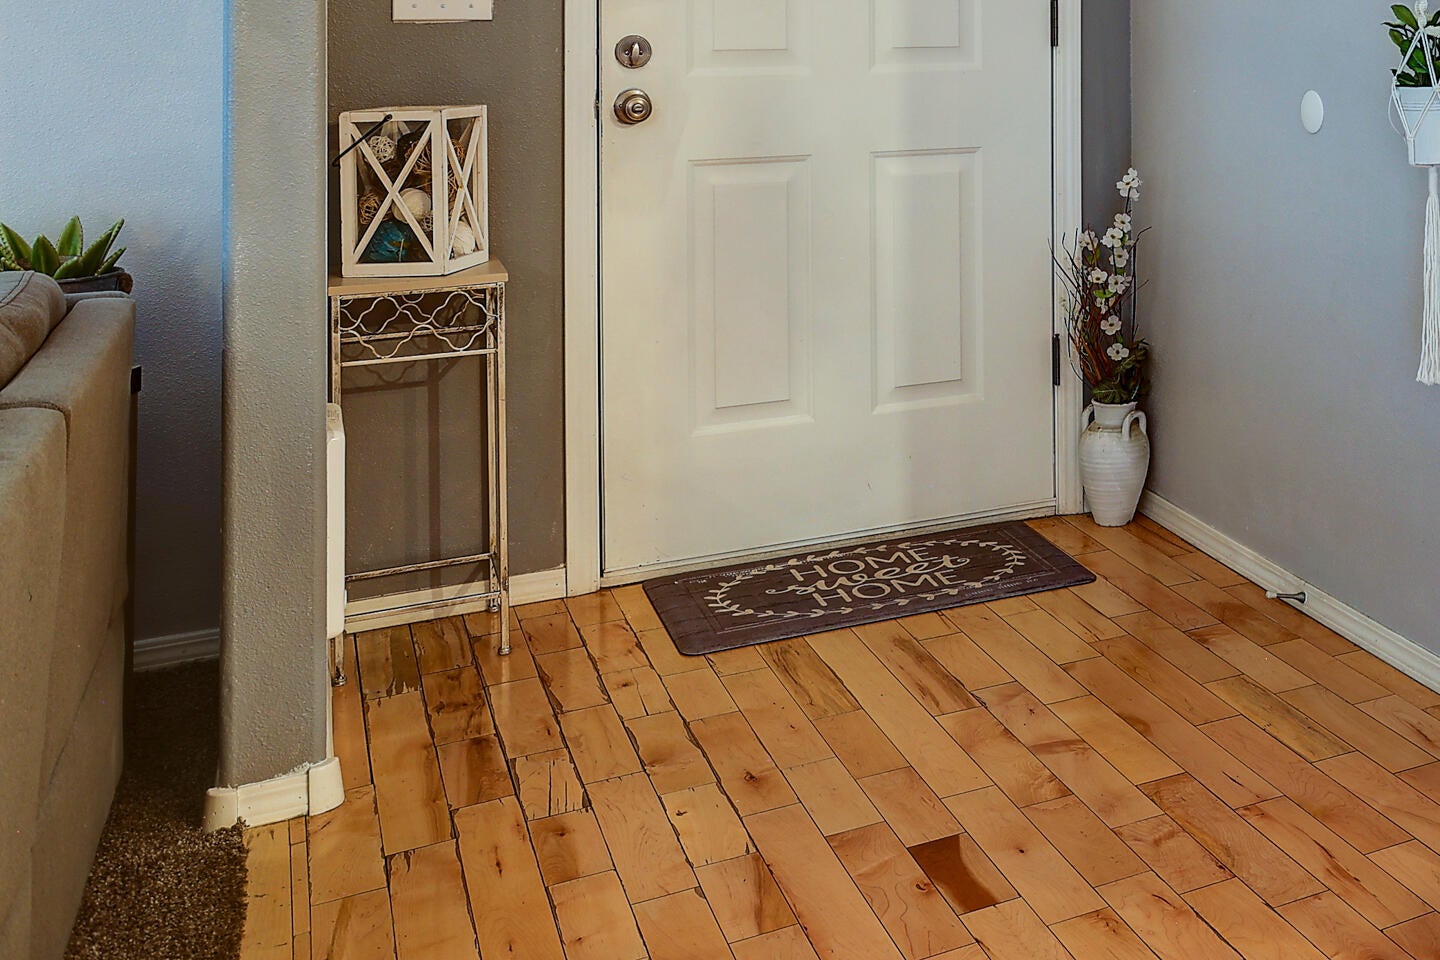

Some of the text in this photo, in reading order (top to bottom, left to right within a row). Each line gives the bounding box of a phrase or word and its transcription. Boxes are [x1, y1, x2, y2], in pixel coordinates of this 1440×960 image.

[766, 555, 970, 595] sweet
[790, 548, 938, 581] HOME
[813, 570, 966, 606] HOME
